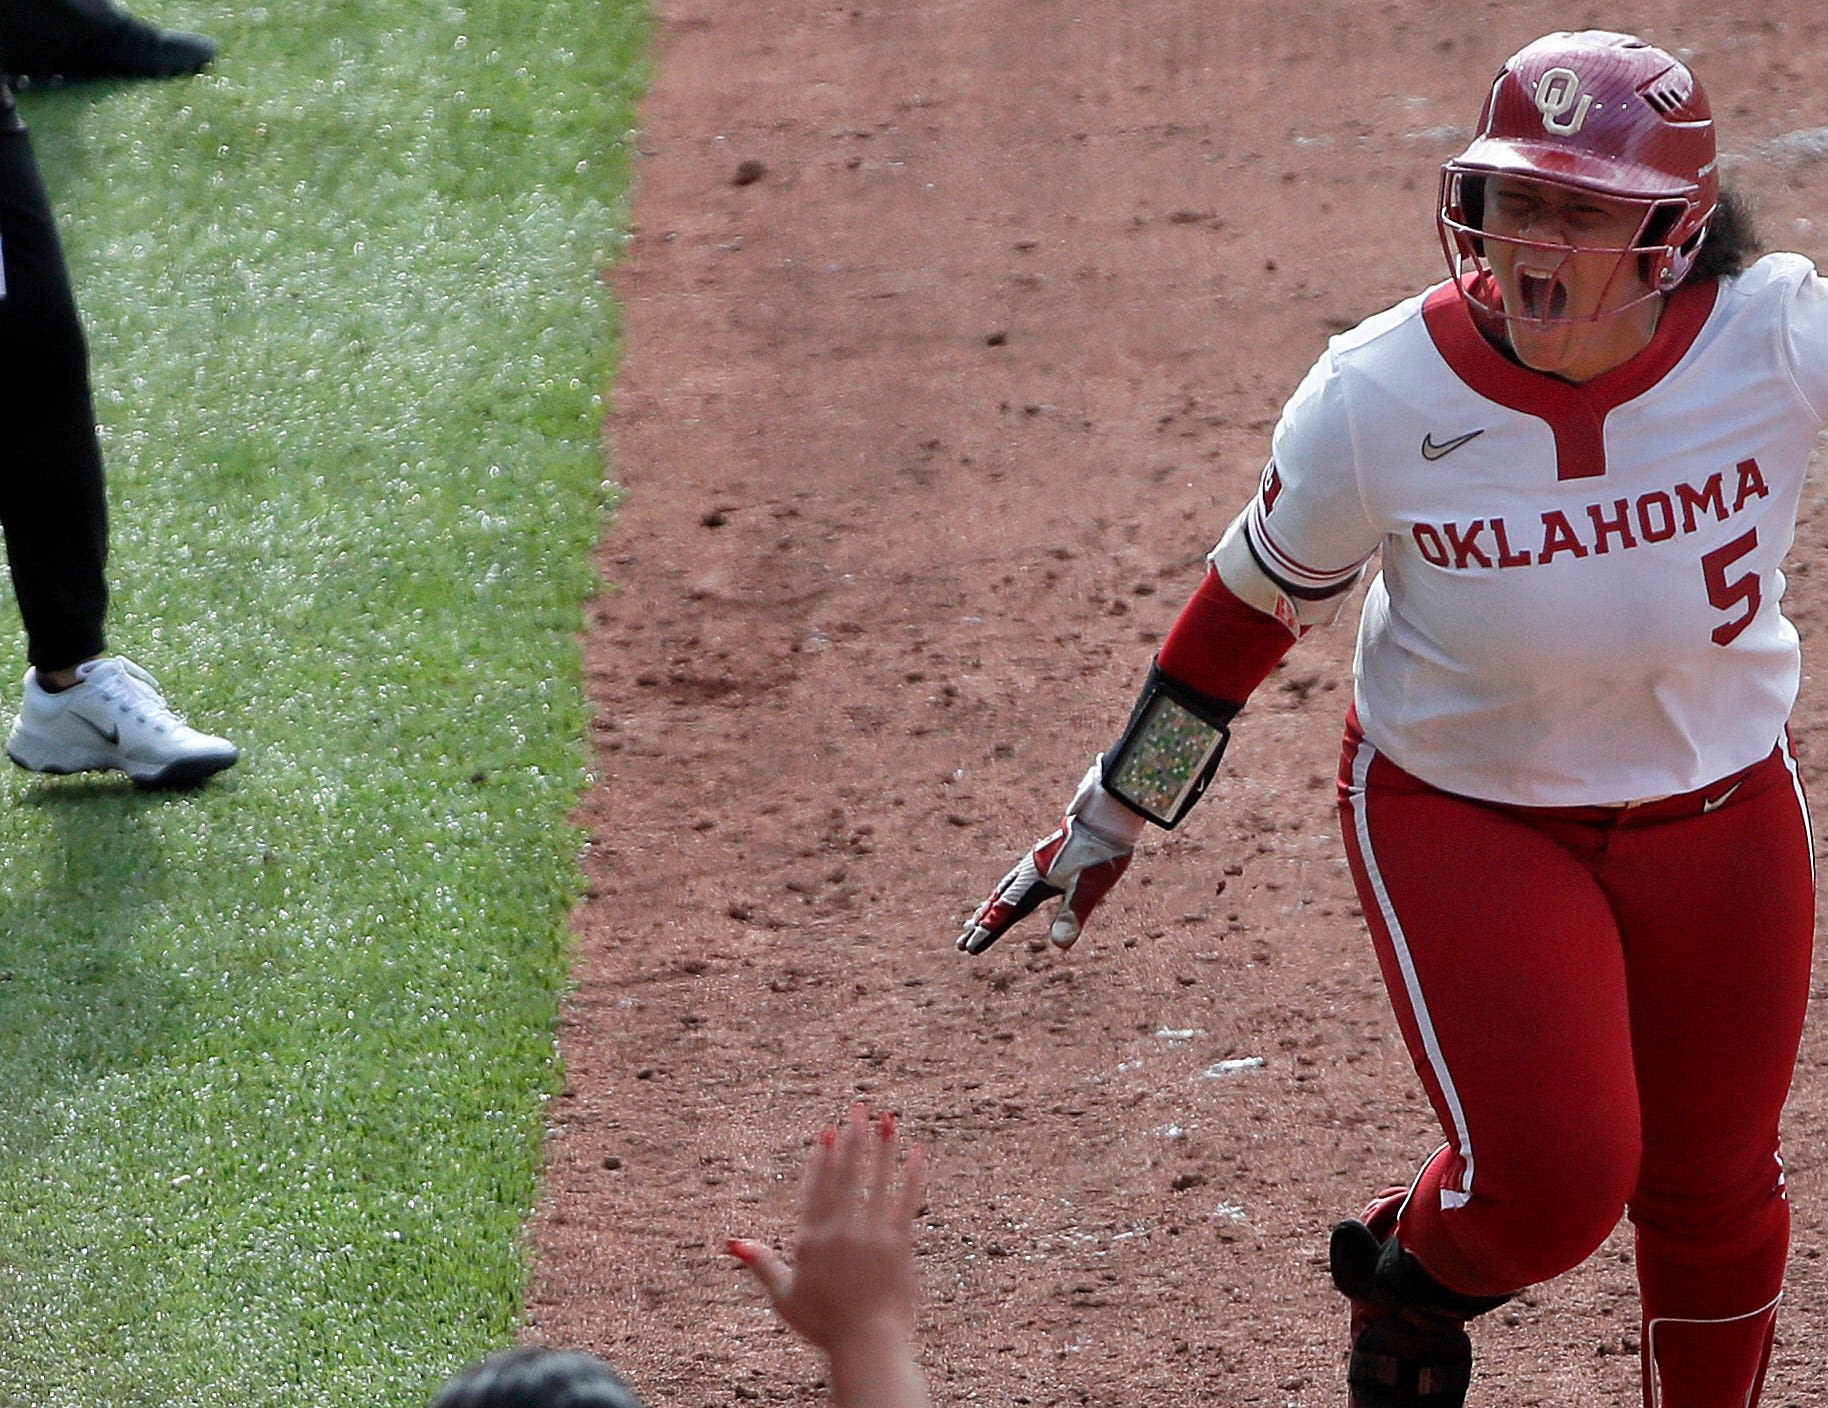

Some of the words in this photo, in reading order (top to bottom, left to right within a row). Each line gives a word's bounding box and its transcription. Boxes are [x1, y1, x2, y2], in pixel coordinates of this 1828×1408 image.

[1535, 67, 1593, 136] OU
[1412, 458, 1769, 569] OKLAHOMA
[1701, 527, 1761, 647] 5
